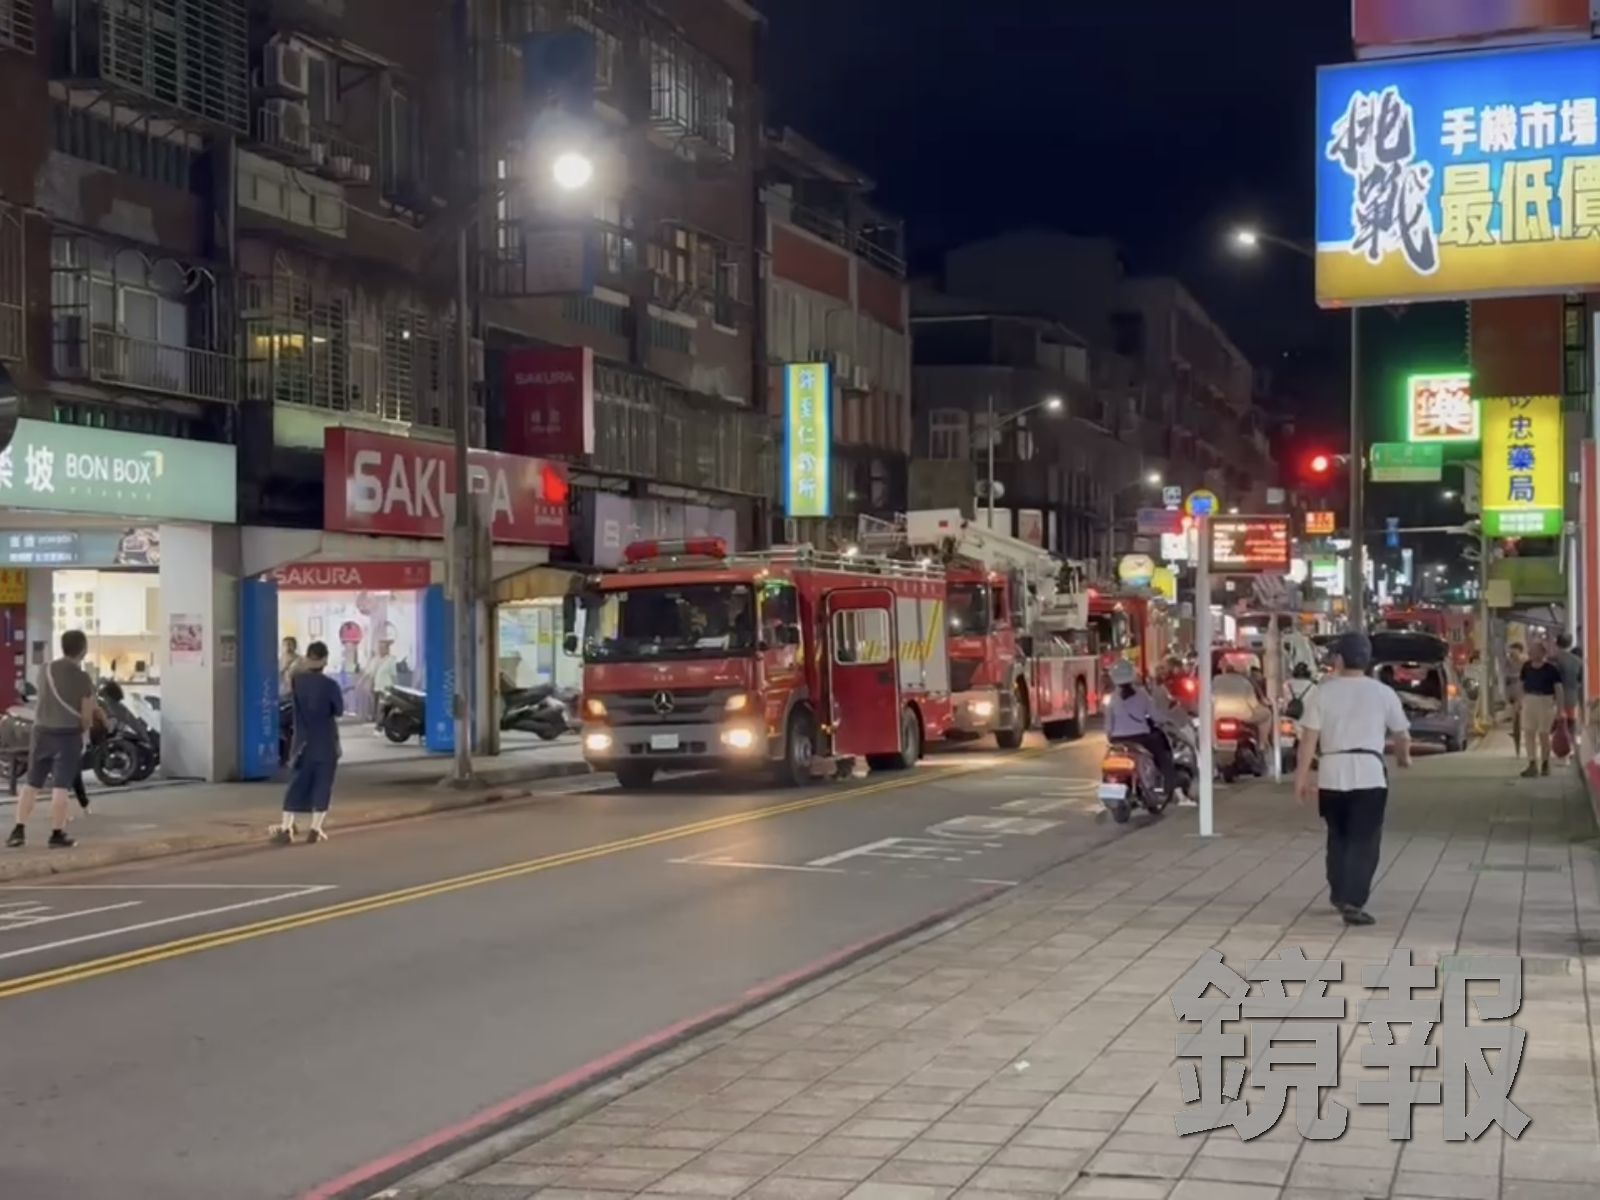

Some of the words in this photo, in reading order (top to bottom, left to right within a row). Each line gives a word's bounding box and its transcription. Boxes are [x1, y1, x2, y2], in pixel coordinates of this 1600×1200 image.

[1441, 99, 1597, 155] 手機市場
[1327, 86, 1439, 275] 挑戰
[514, 371, 576, 385] SAKURA
[66, 453, 109, 481] BON
[113, 458, 152, 486] BOX
[273, 567, 362, 585] SAKURA
